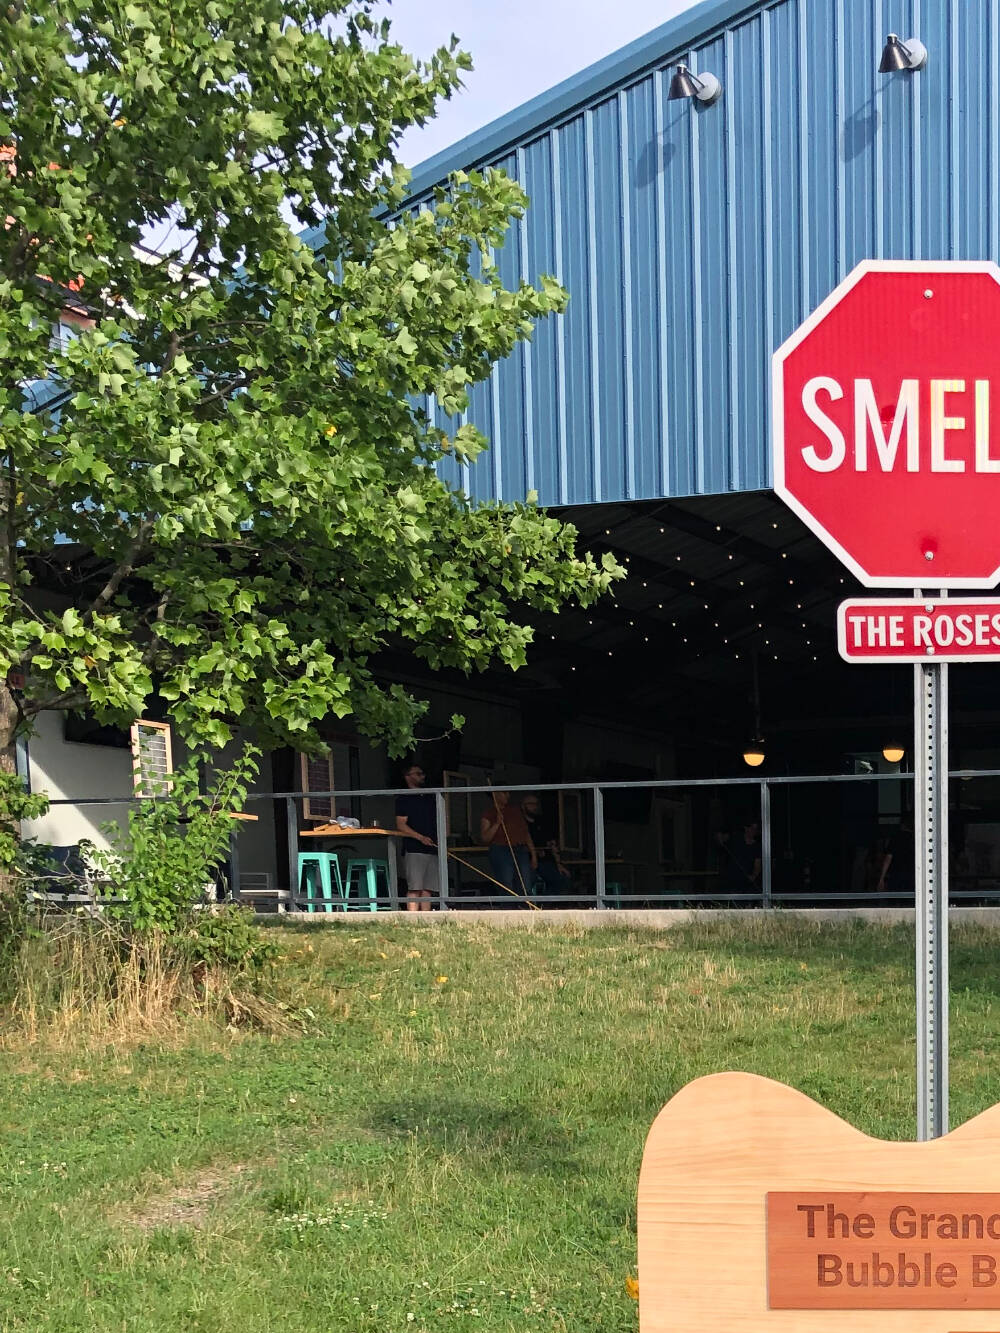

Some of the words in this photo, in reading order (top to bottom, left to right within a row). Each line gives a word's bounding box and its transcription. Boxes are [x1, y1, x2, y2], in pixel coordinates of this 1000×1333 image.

[849, 615, 904, 647] THE
[797, 1204, 875, 1239] The
[817, 1253, 958, 1288] Bubble
